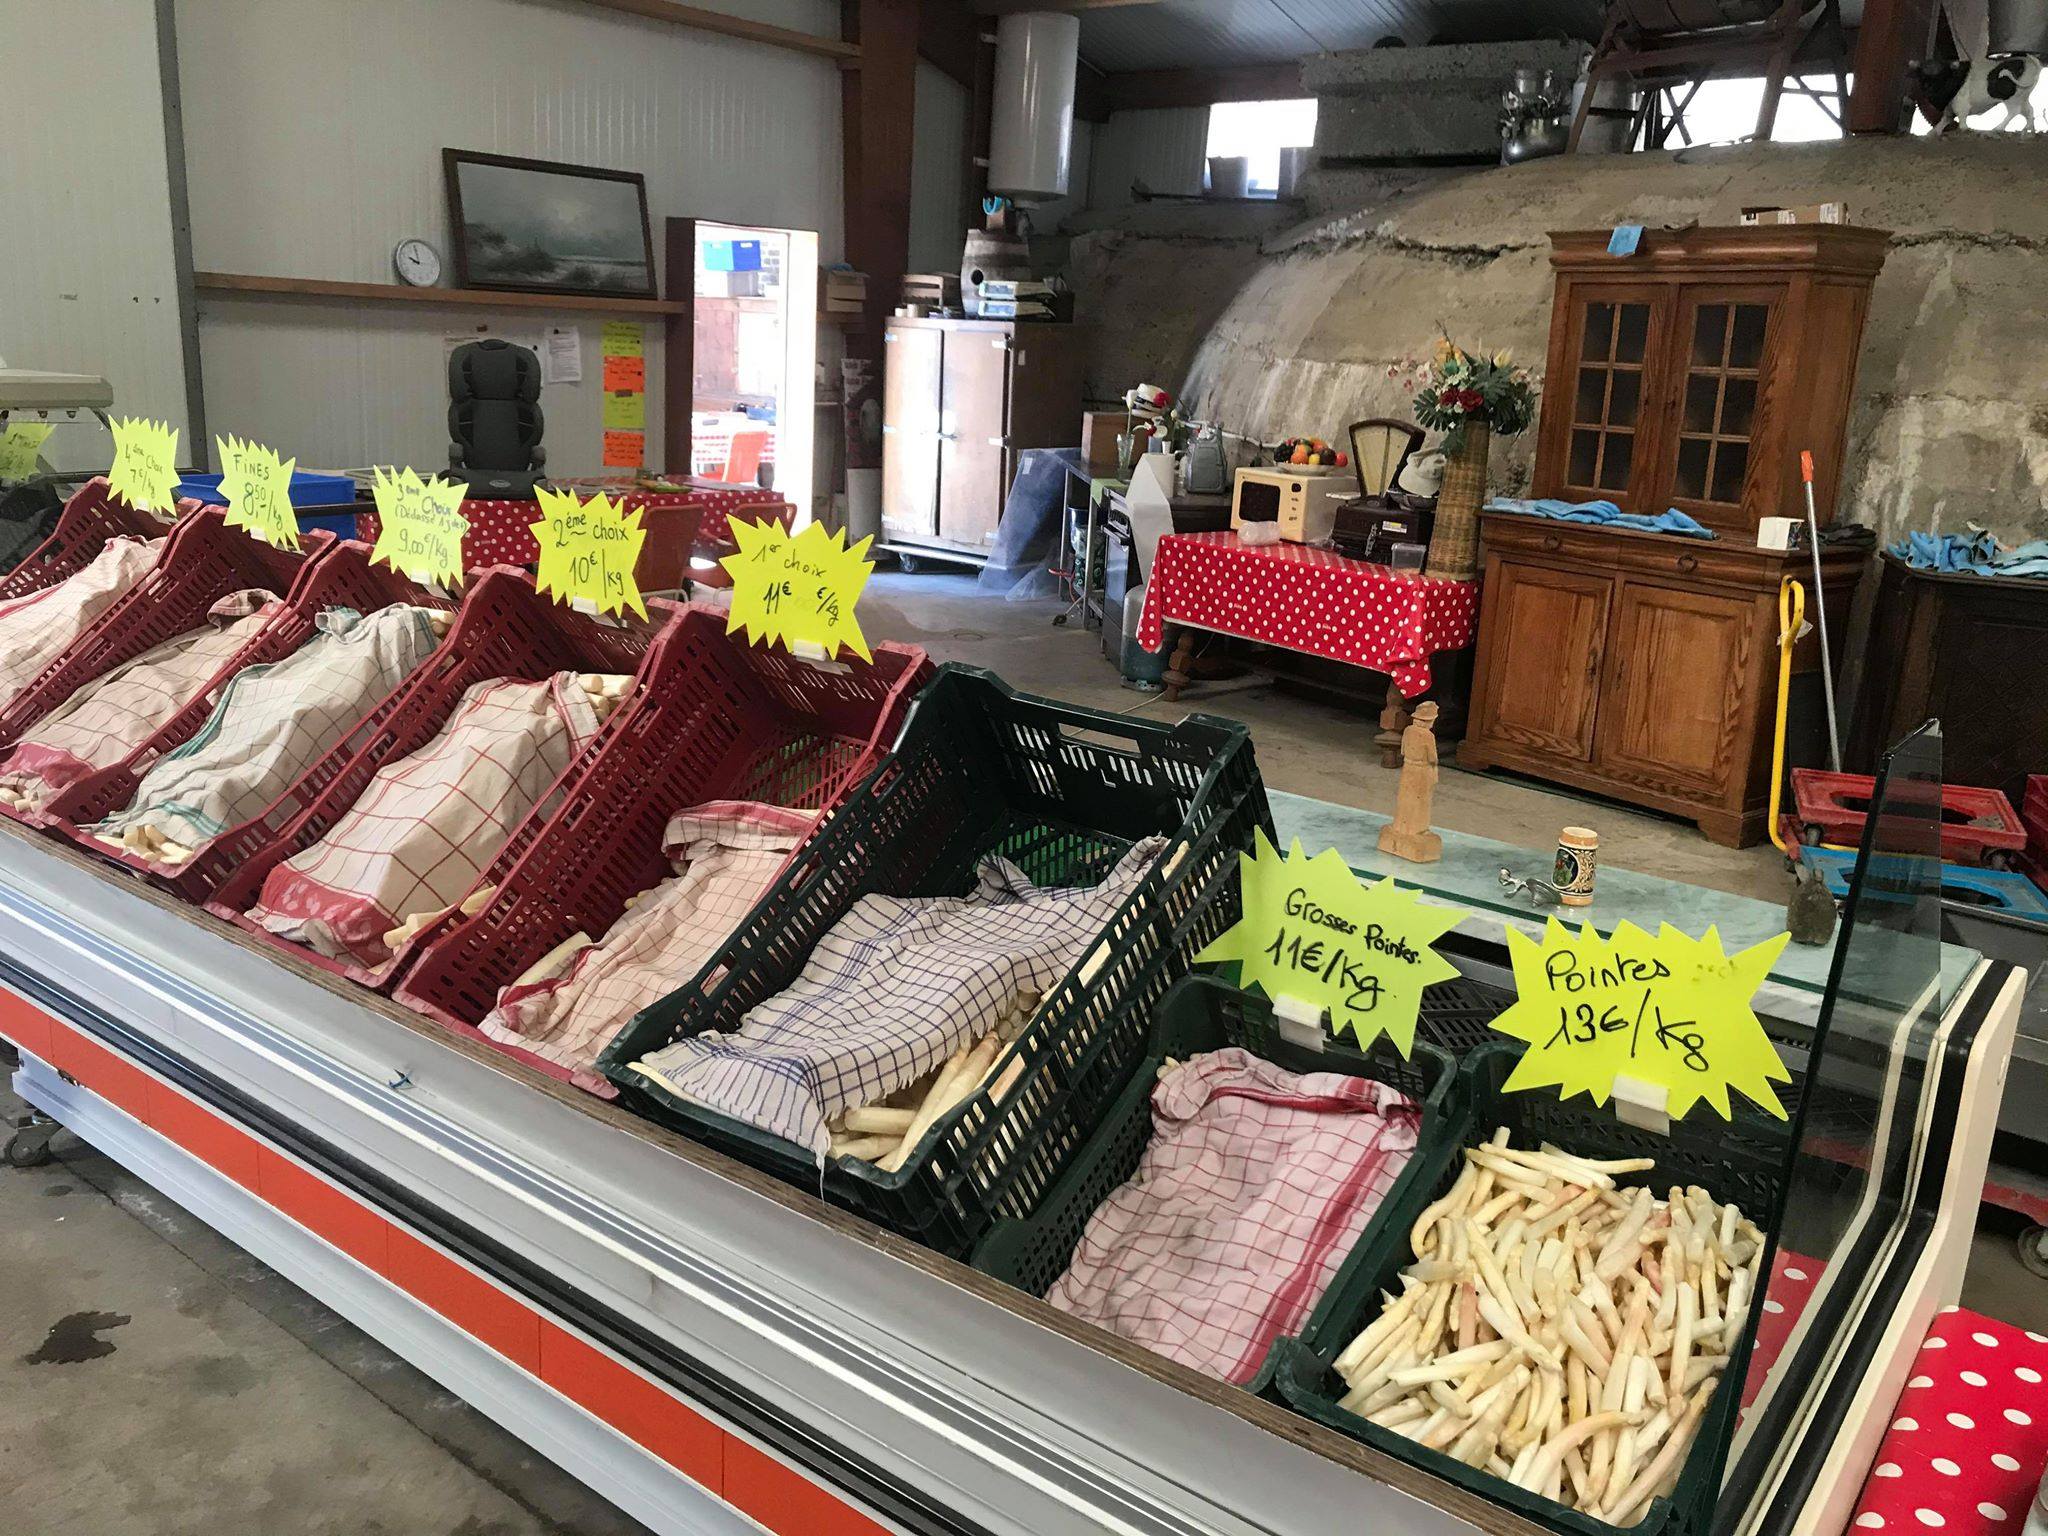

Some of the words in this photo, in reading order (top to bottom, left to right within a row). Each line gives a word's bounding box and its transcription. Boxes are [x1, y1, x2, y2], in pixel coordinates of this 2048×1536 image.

[592, 516, 630, 541] choix
[783, 548, 828, 578] choix
[1284, 887, 1358, 935] Grosses
[1545, 949, 1672, 992] Pointes
